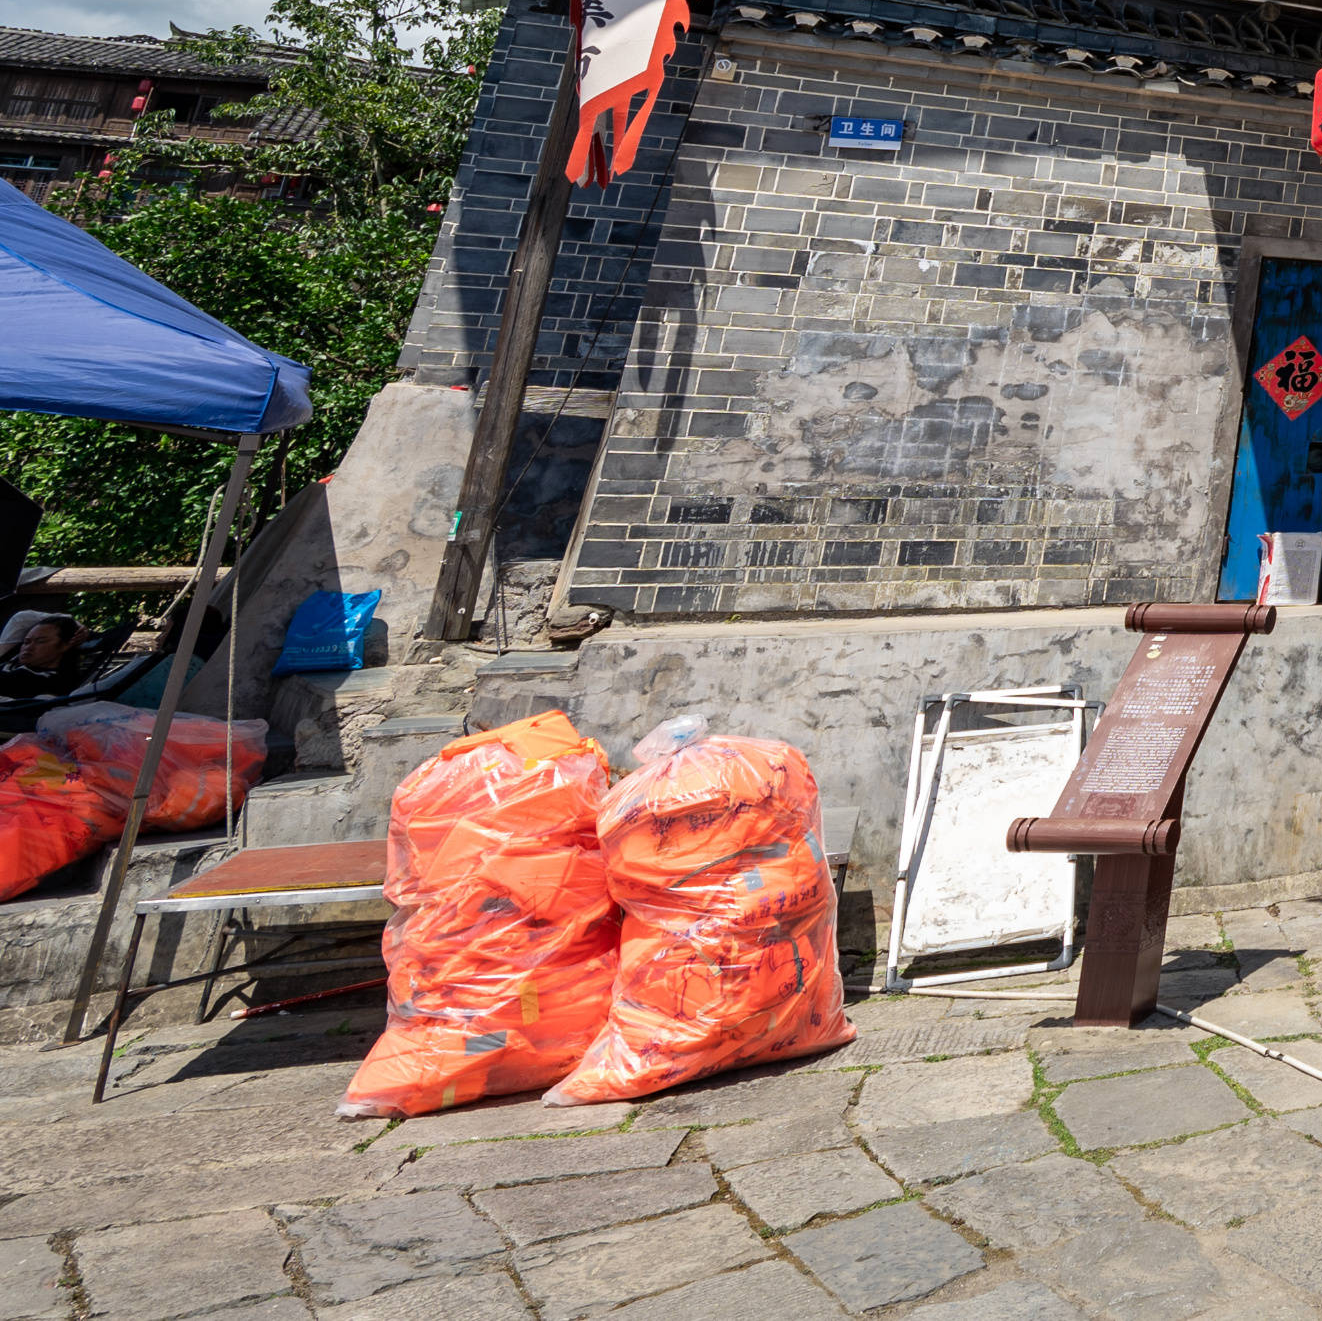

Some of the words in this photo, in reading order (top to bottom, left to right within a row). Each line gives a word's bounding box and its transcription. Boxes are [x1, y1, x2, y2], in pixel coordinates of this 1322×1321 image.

[838, 121, 896, 137] 卫生间
[1275, 350, 1319, 392] 福
